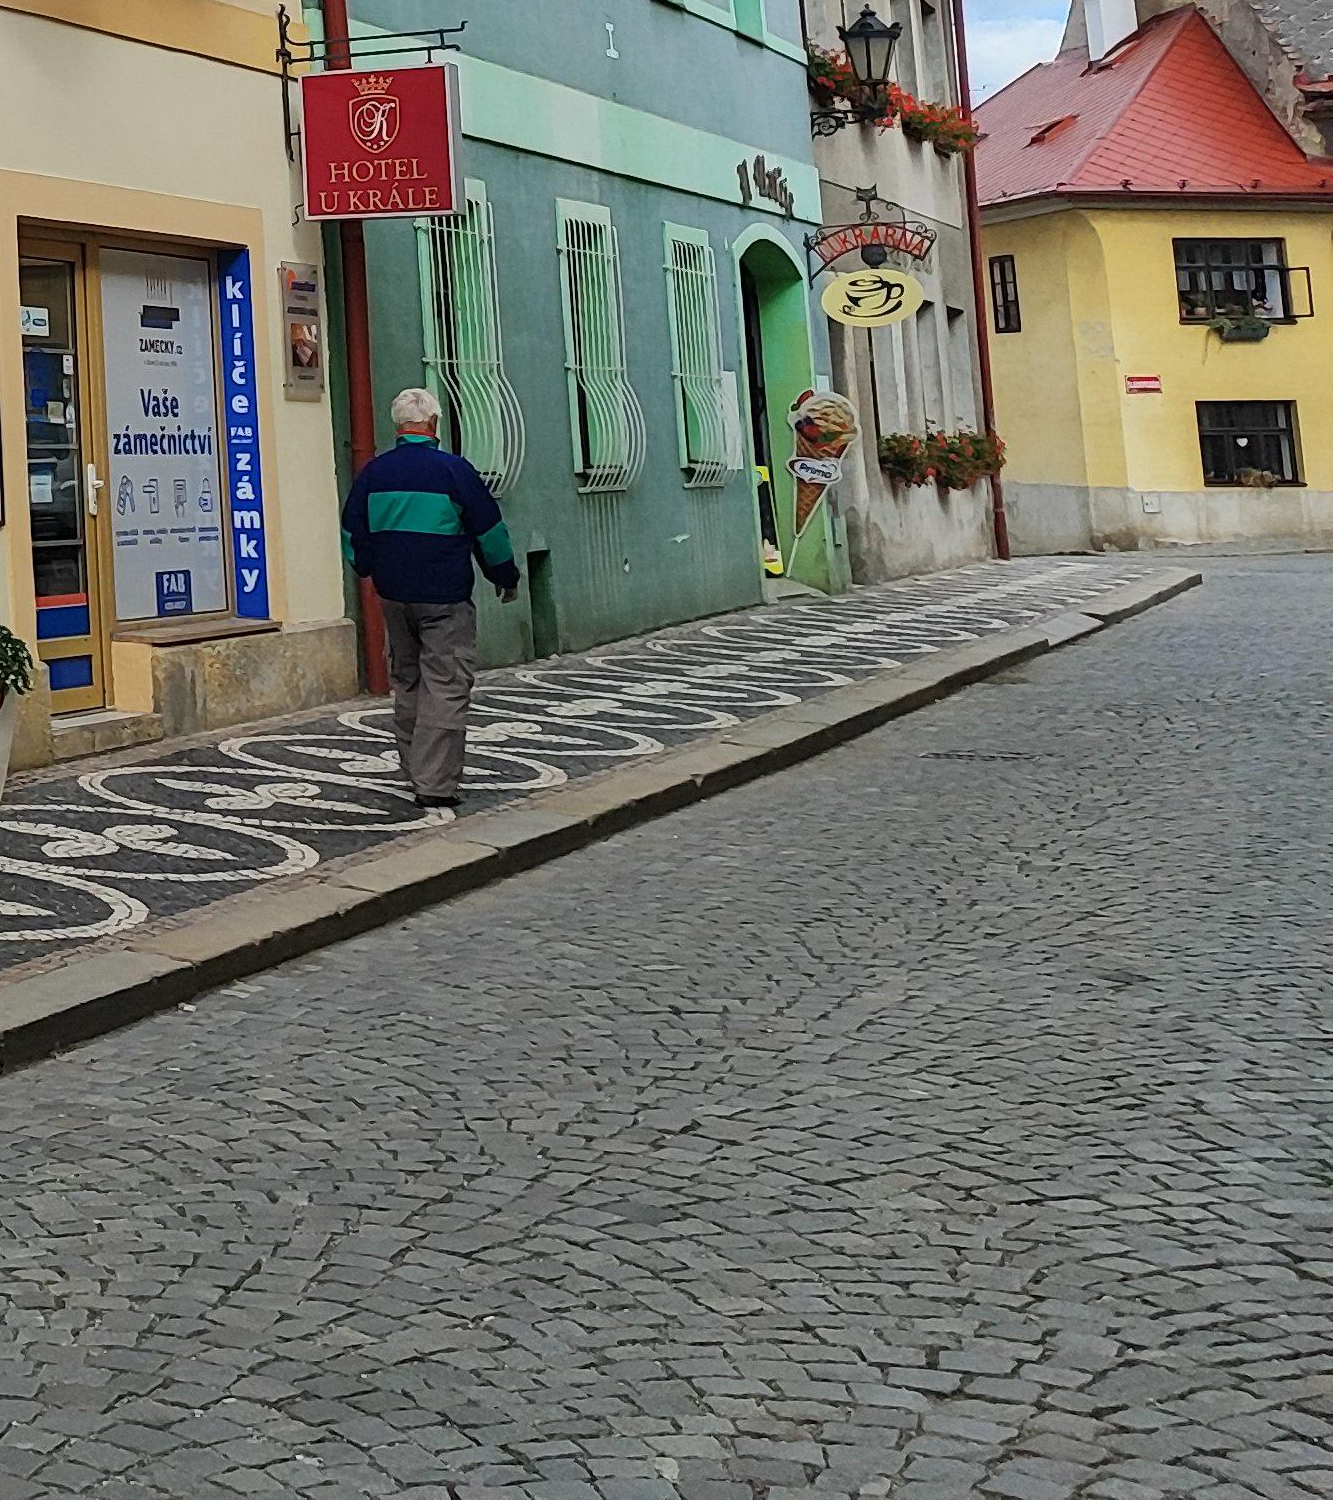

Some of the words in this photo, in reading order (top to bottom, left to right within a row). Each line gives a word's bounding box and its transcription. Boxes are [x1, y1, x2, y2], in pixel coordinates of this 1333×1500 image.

[328, 158, 428, 184] HOTEL
[319, 190, 340, 213] U
[347, 181, 440, 212] KRÁLE
[225, 275, 250, 414] klíče
[140, 388, 180, 418] Vaše
[113, 425, 213, 456] zámečnictví
[230, 426, 253, 438] FAB
[233, 452, 262, 593] zámky
[162, 573, 186, 596] FAB
